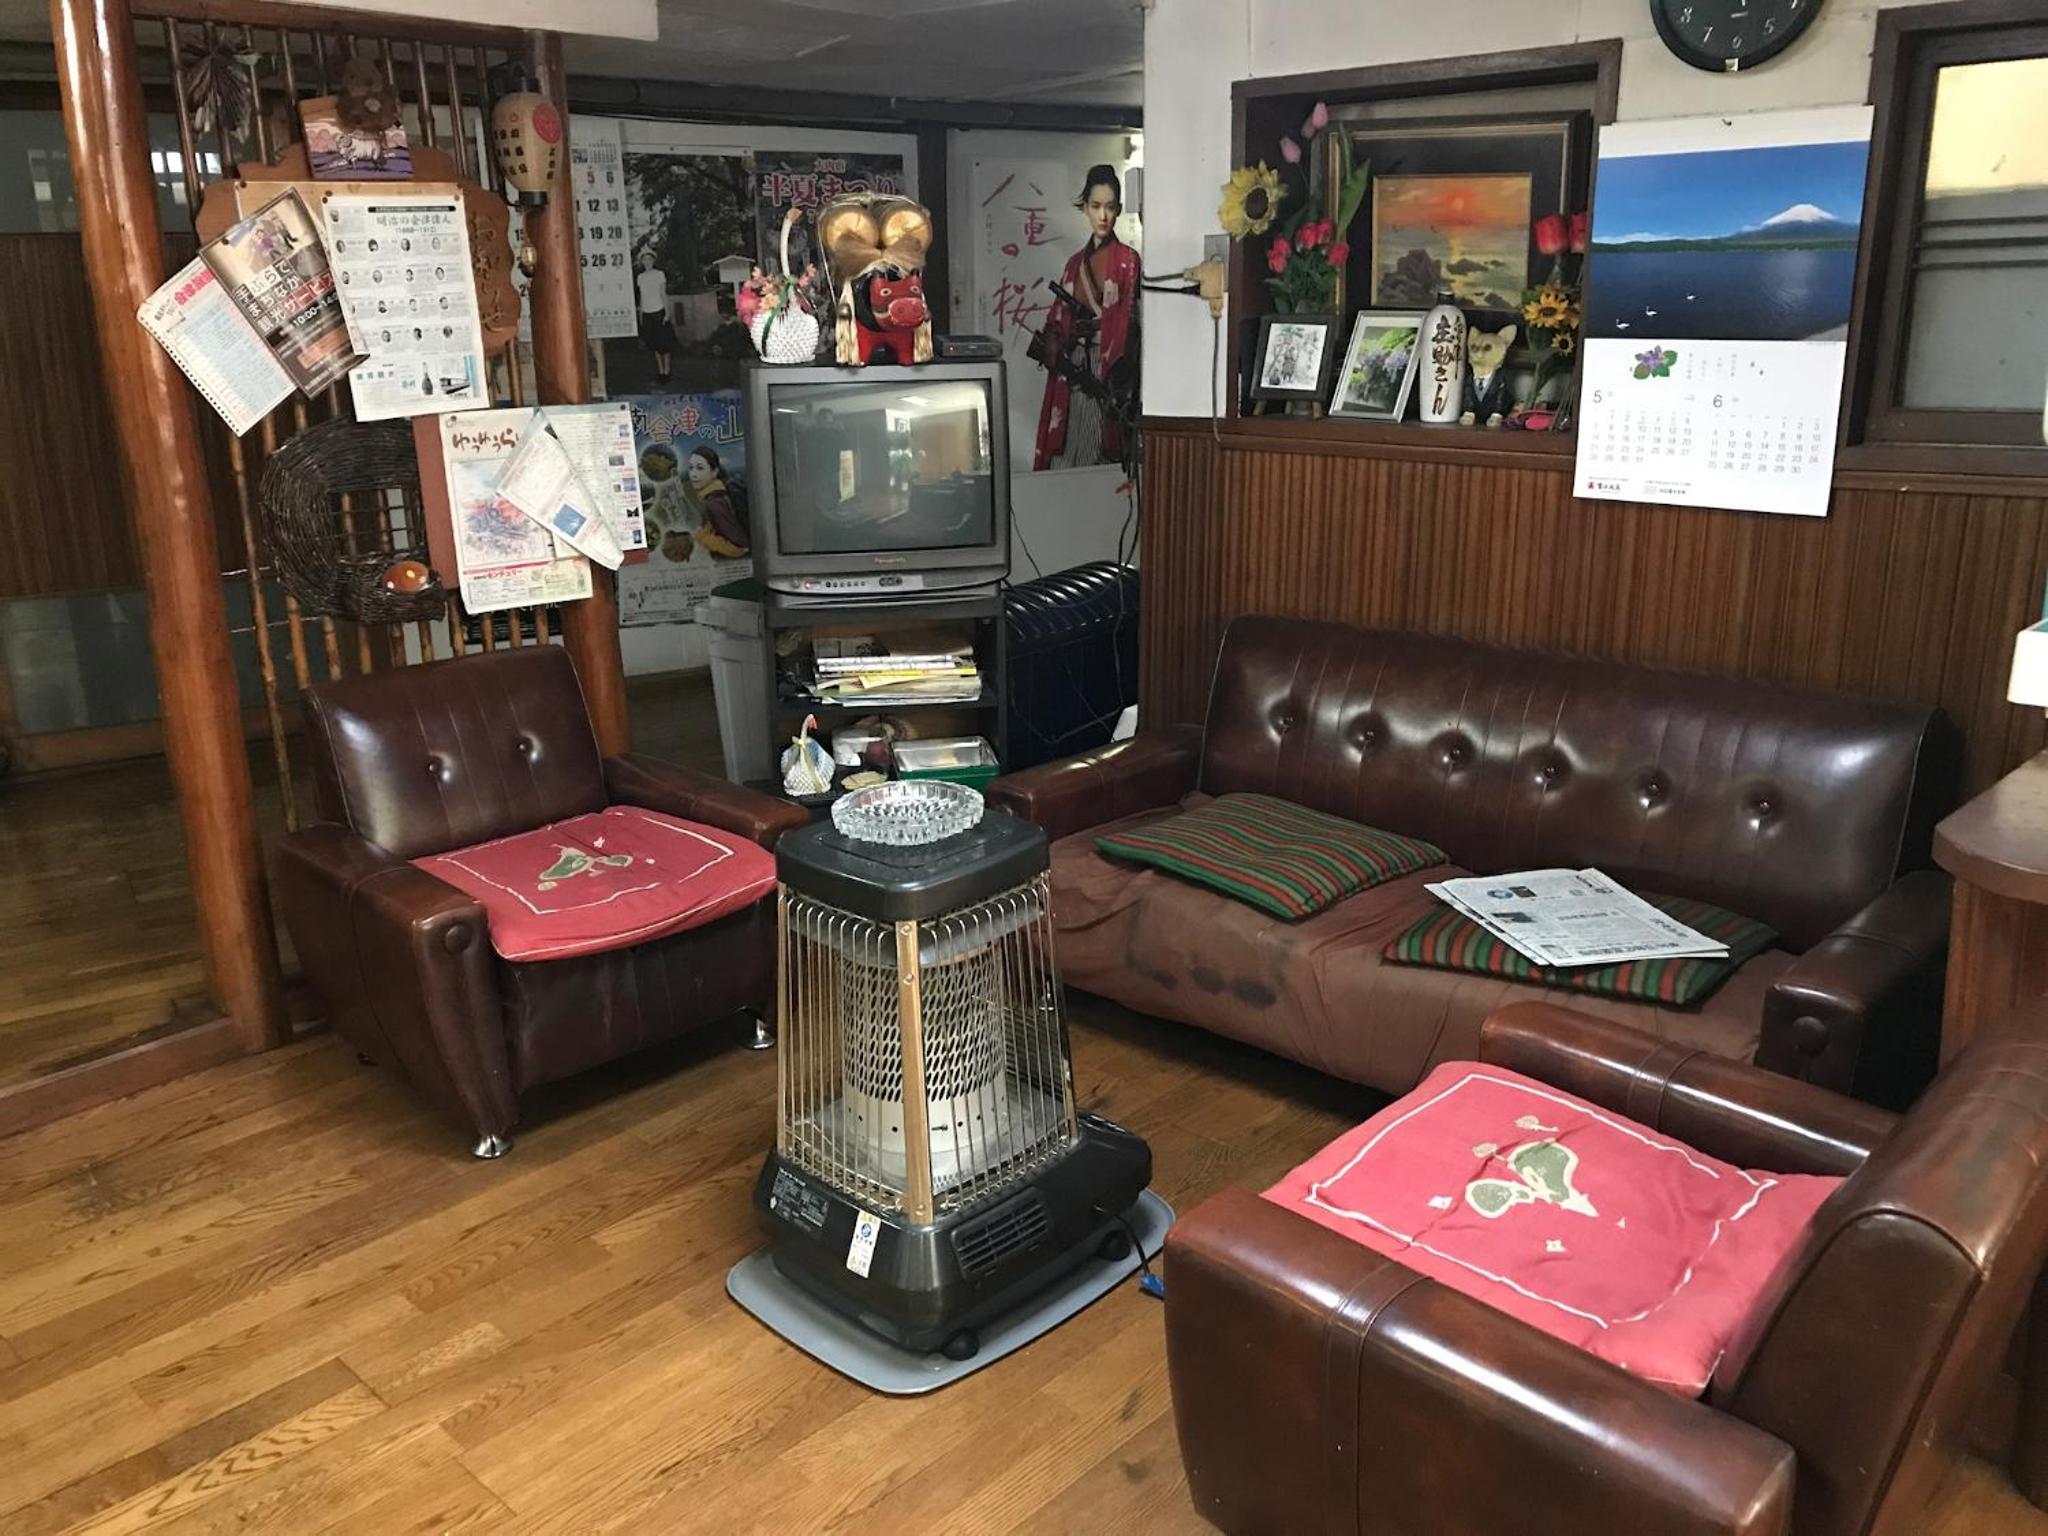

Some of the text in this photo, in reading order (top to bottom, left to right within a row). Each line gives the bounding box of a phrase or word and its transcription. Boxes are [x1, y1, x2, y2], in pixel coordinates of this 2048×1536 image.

[1680, 7, 1693, 24] 8
[1764, 17, 1777, 34] 5
[1703, 26, 1714, 43] 7
[1731, 32, 1743, 49] 6
[587, 172, 614, 184] 5 6
[762, 173, 897, 207] 半夏まつり
[588, 200, 600, 212] 12
[606, 200, 619, 212] 13
[590, 227, 603, 239] 19
[608, 226, 622, 239] 20
[592, 255, 606, 267] 26
[611, 254, 624, 267] 27
[248, 274, 300, 317] まちなか
[1593, 390, 1602, 403] 5
[1713, 394, 1723, 408] 6
